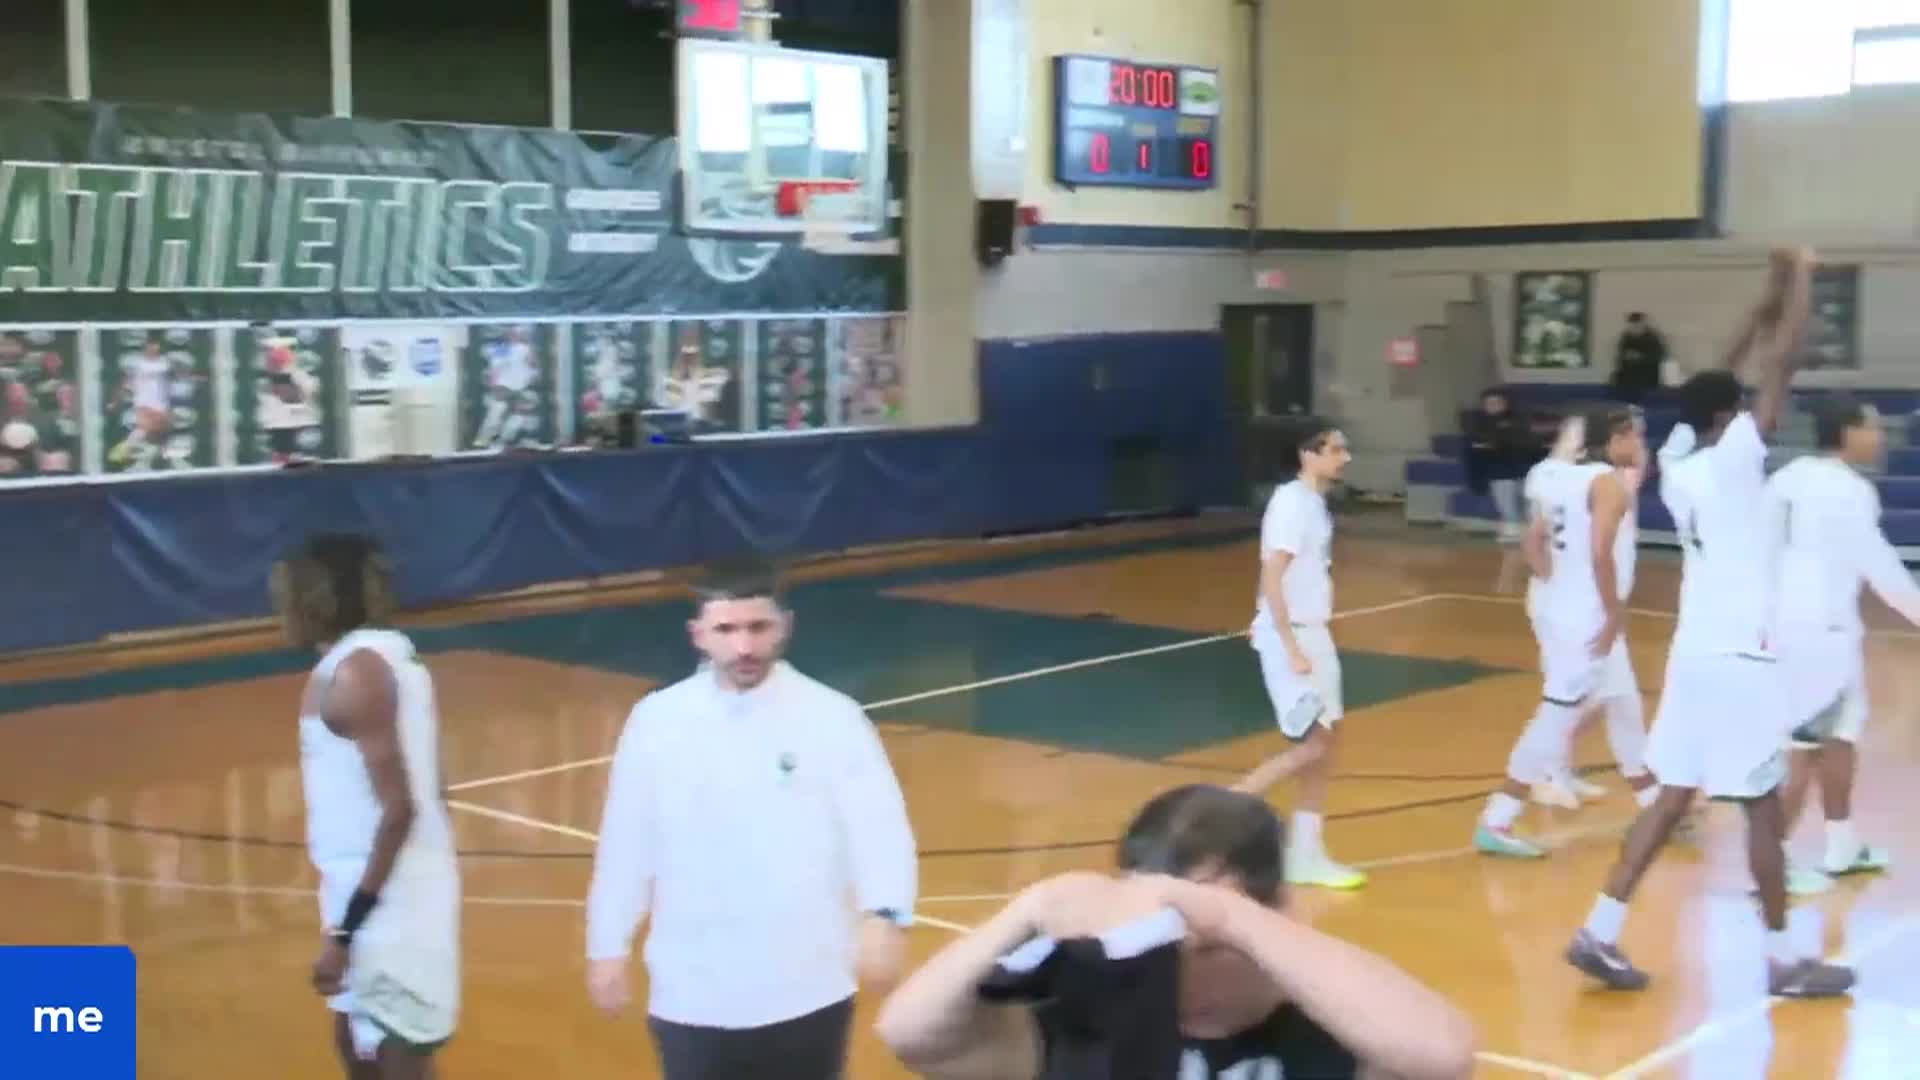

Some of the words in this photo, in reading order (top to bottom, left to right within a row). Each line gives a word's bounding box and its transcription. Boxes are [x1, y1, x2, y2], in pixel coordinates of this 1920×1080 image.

[1108, 64, 1174, 108] 20:00
[1091, 132, 1109, 174] 0
[1139, 143, 1149, 170] 1
[1191, 140, 1210, 178] 0
[0, 160, 551, 293] ATHLETICS
